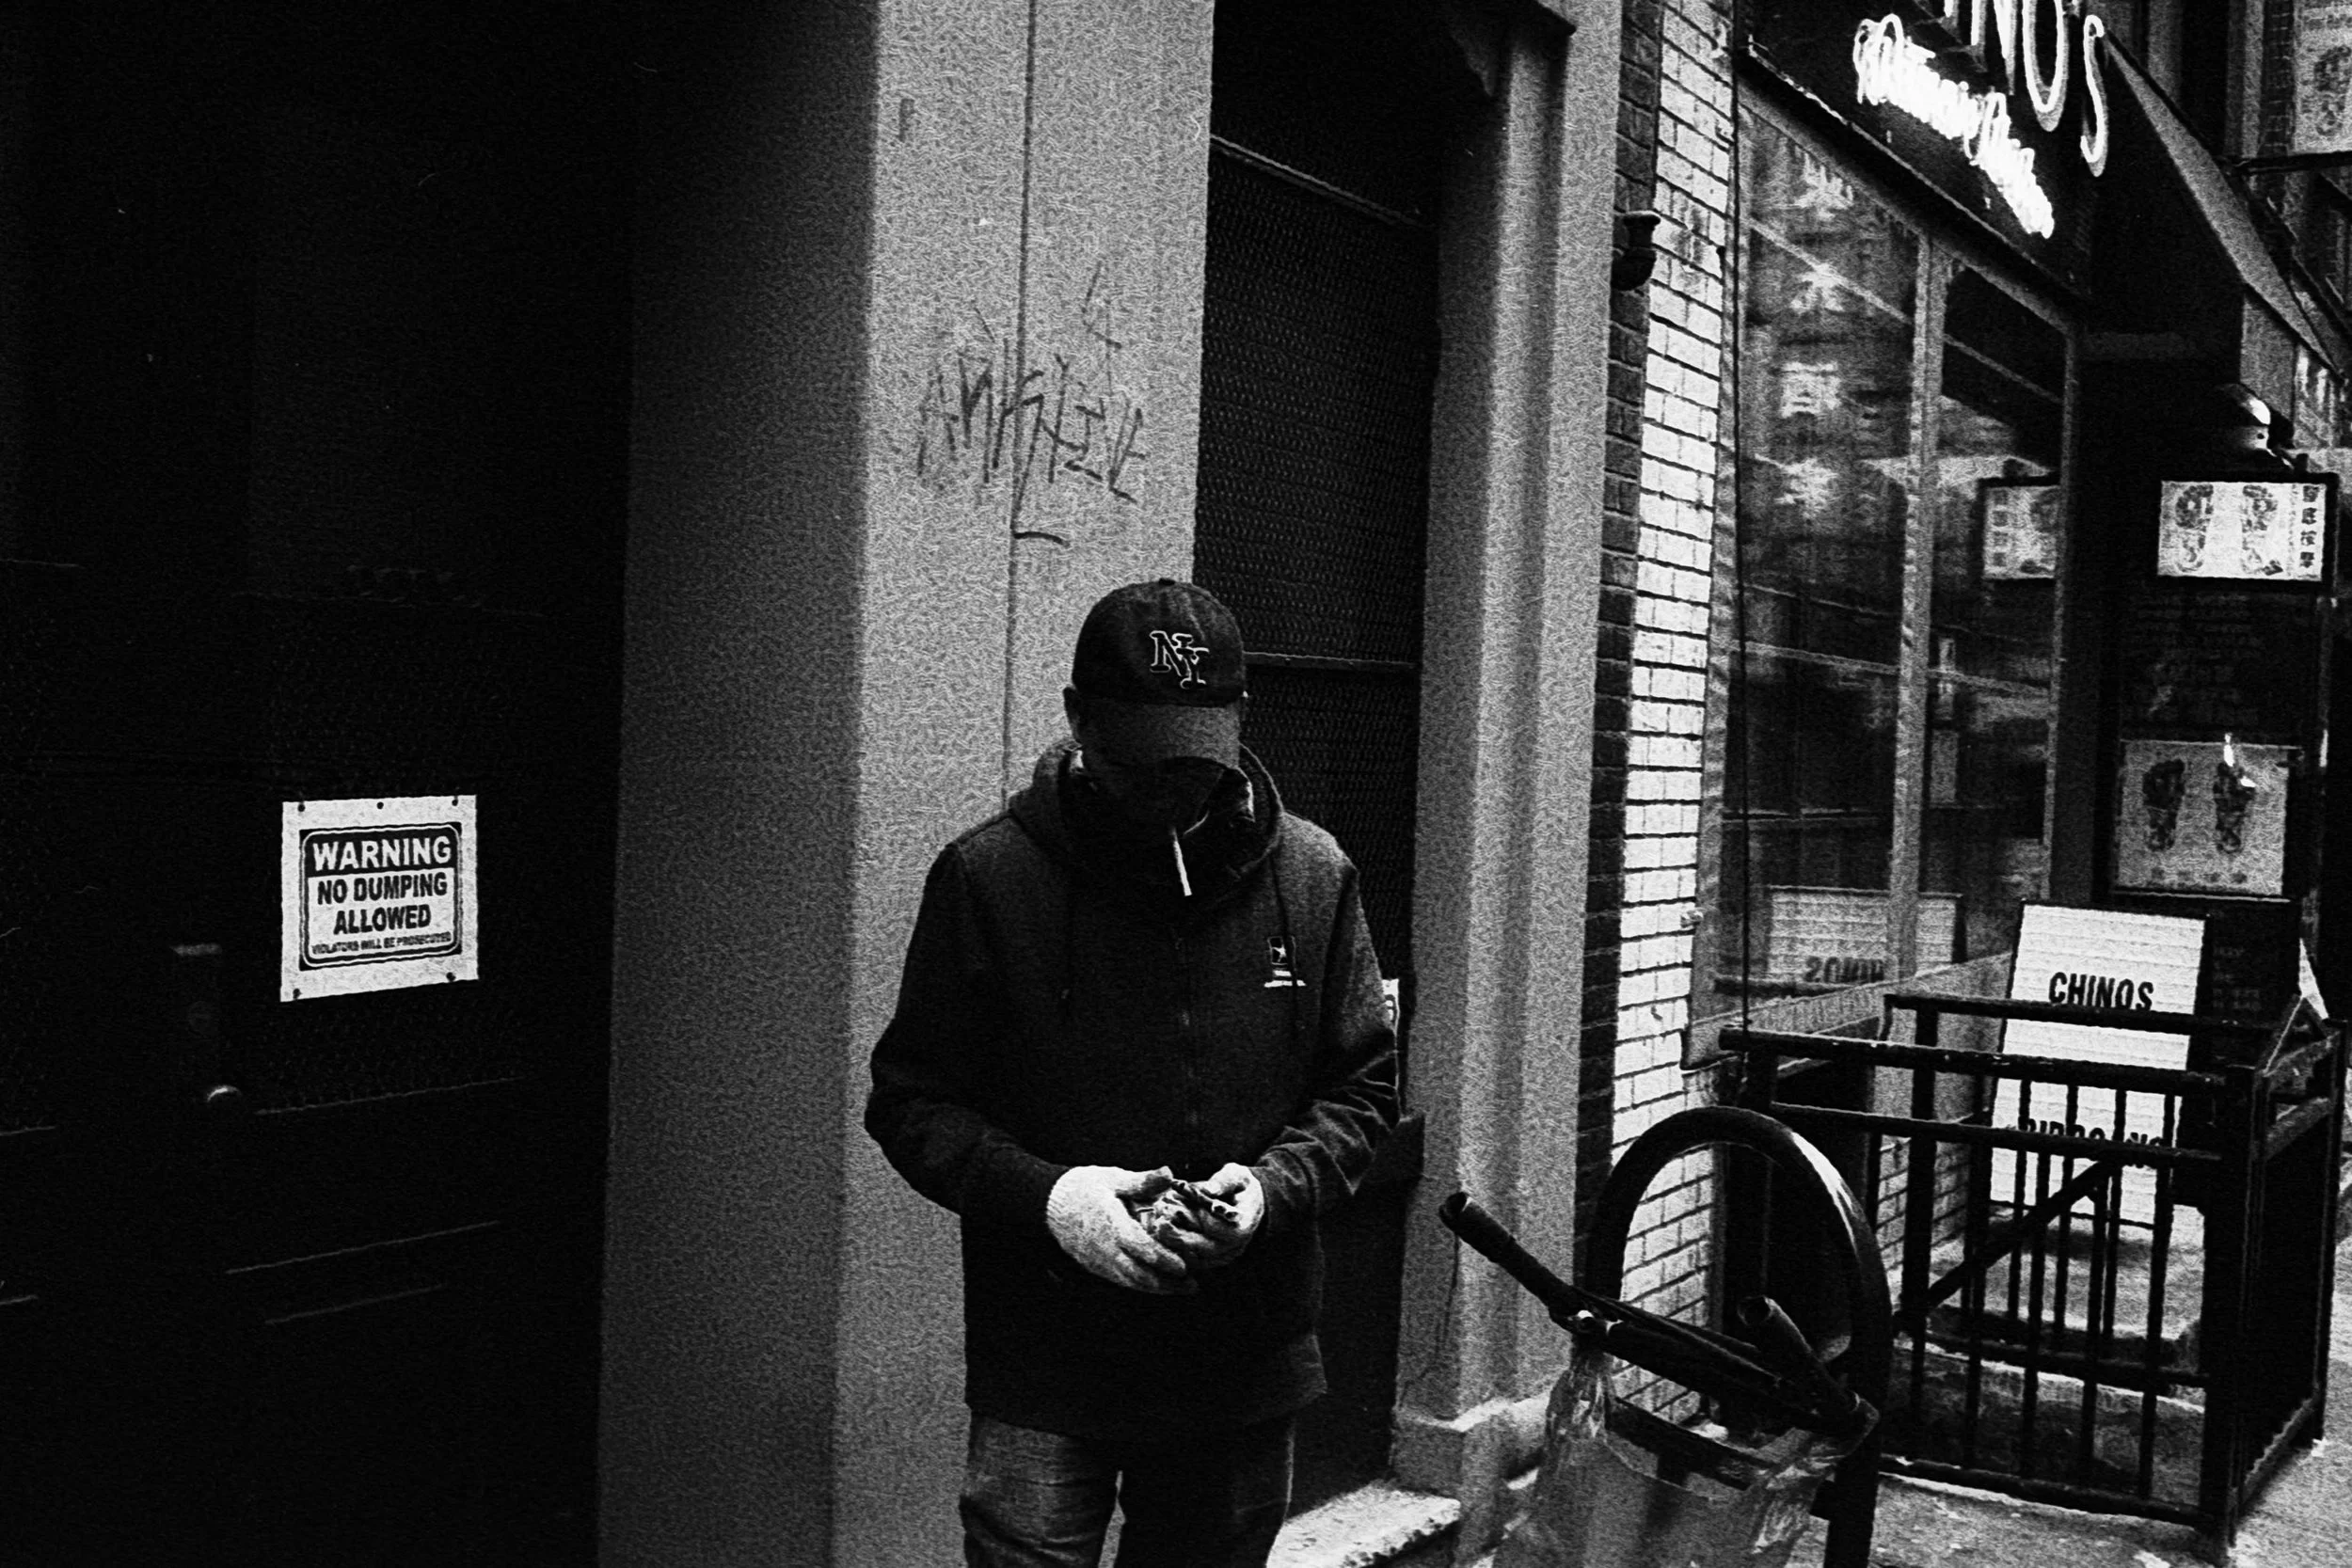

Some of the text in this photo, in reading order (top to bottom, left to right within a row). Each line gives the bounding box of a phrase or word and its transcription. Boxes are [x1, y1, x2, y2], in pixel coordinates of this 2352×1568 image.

[1149, 629, 1210, 689] NY
[312, 835, 452, 871] WARNING
[317, 872, 448, 905] NO DUMPING
[333, 904, 431, 935] ALLOWED
[2048, 972, 2154, 1011] CHINOS
